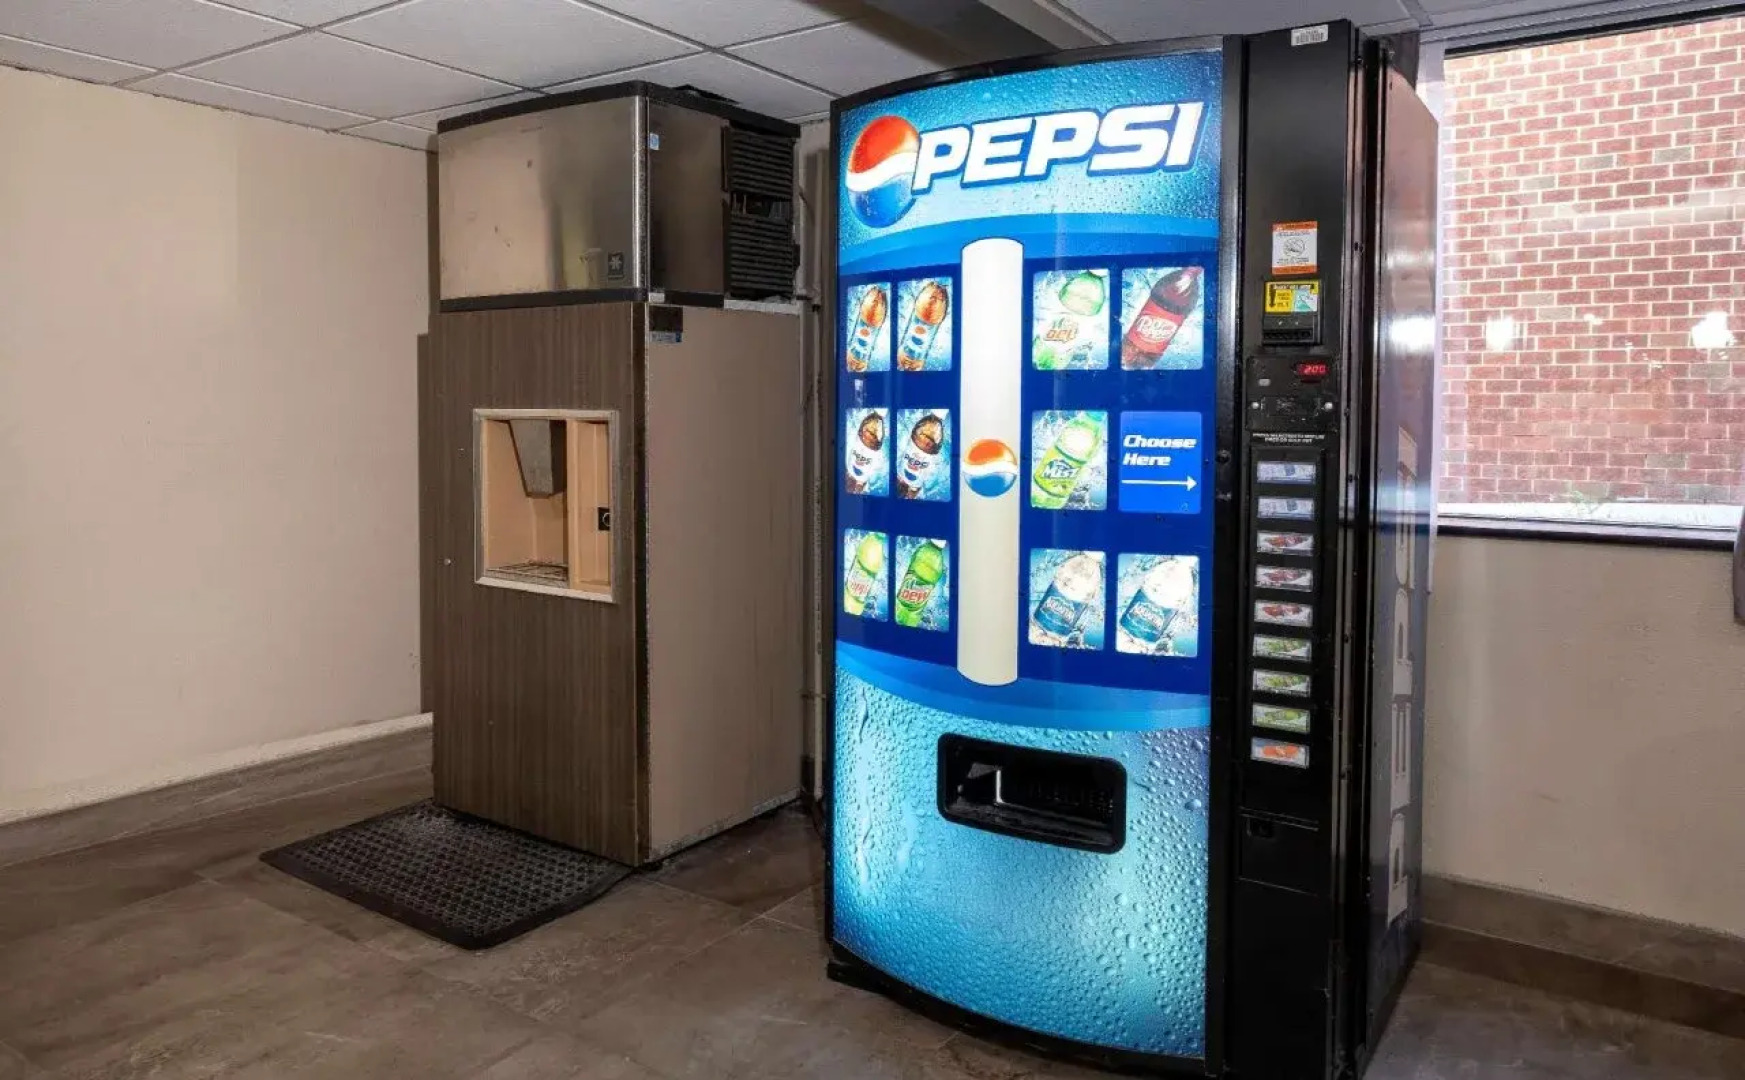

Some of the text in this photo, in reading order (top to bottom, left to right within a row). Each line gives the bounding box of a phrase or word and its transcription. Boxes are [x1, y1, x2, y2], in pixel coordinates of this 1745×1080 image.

[911, 101, 1208, 193] PEPSI
[1122, 434, 1197, 448] Choose
[1122, 453, 1171, 466] Here
